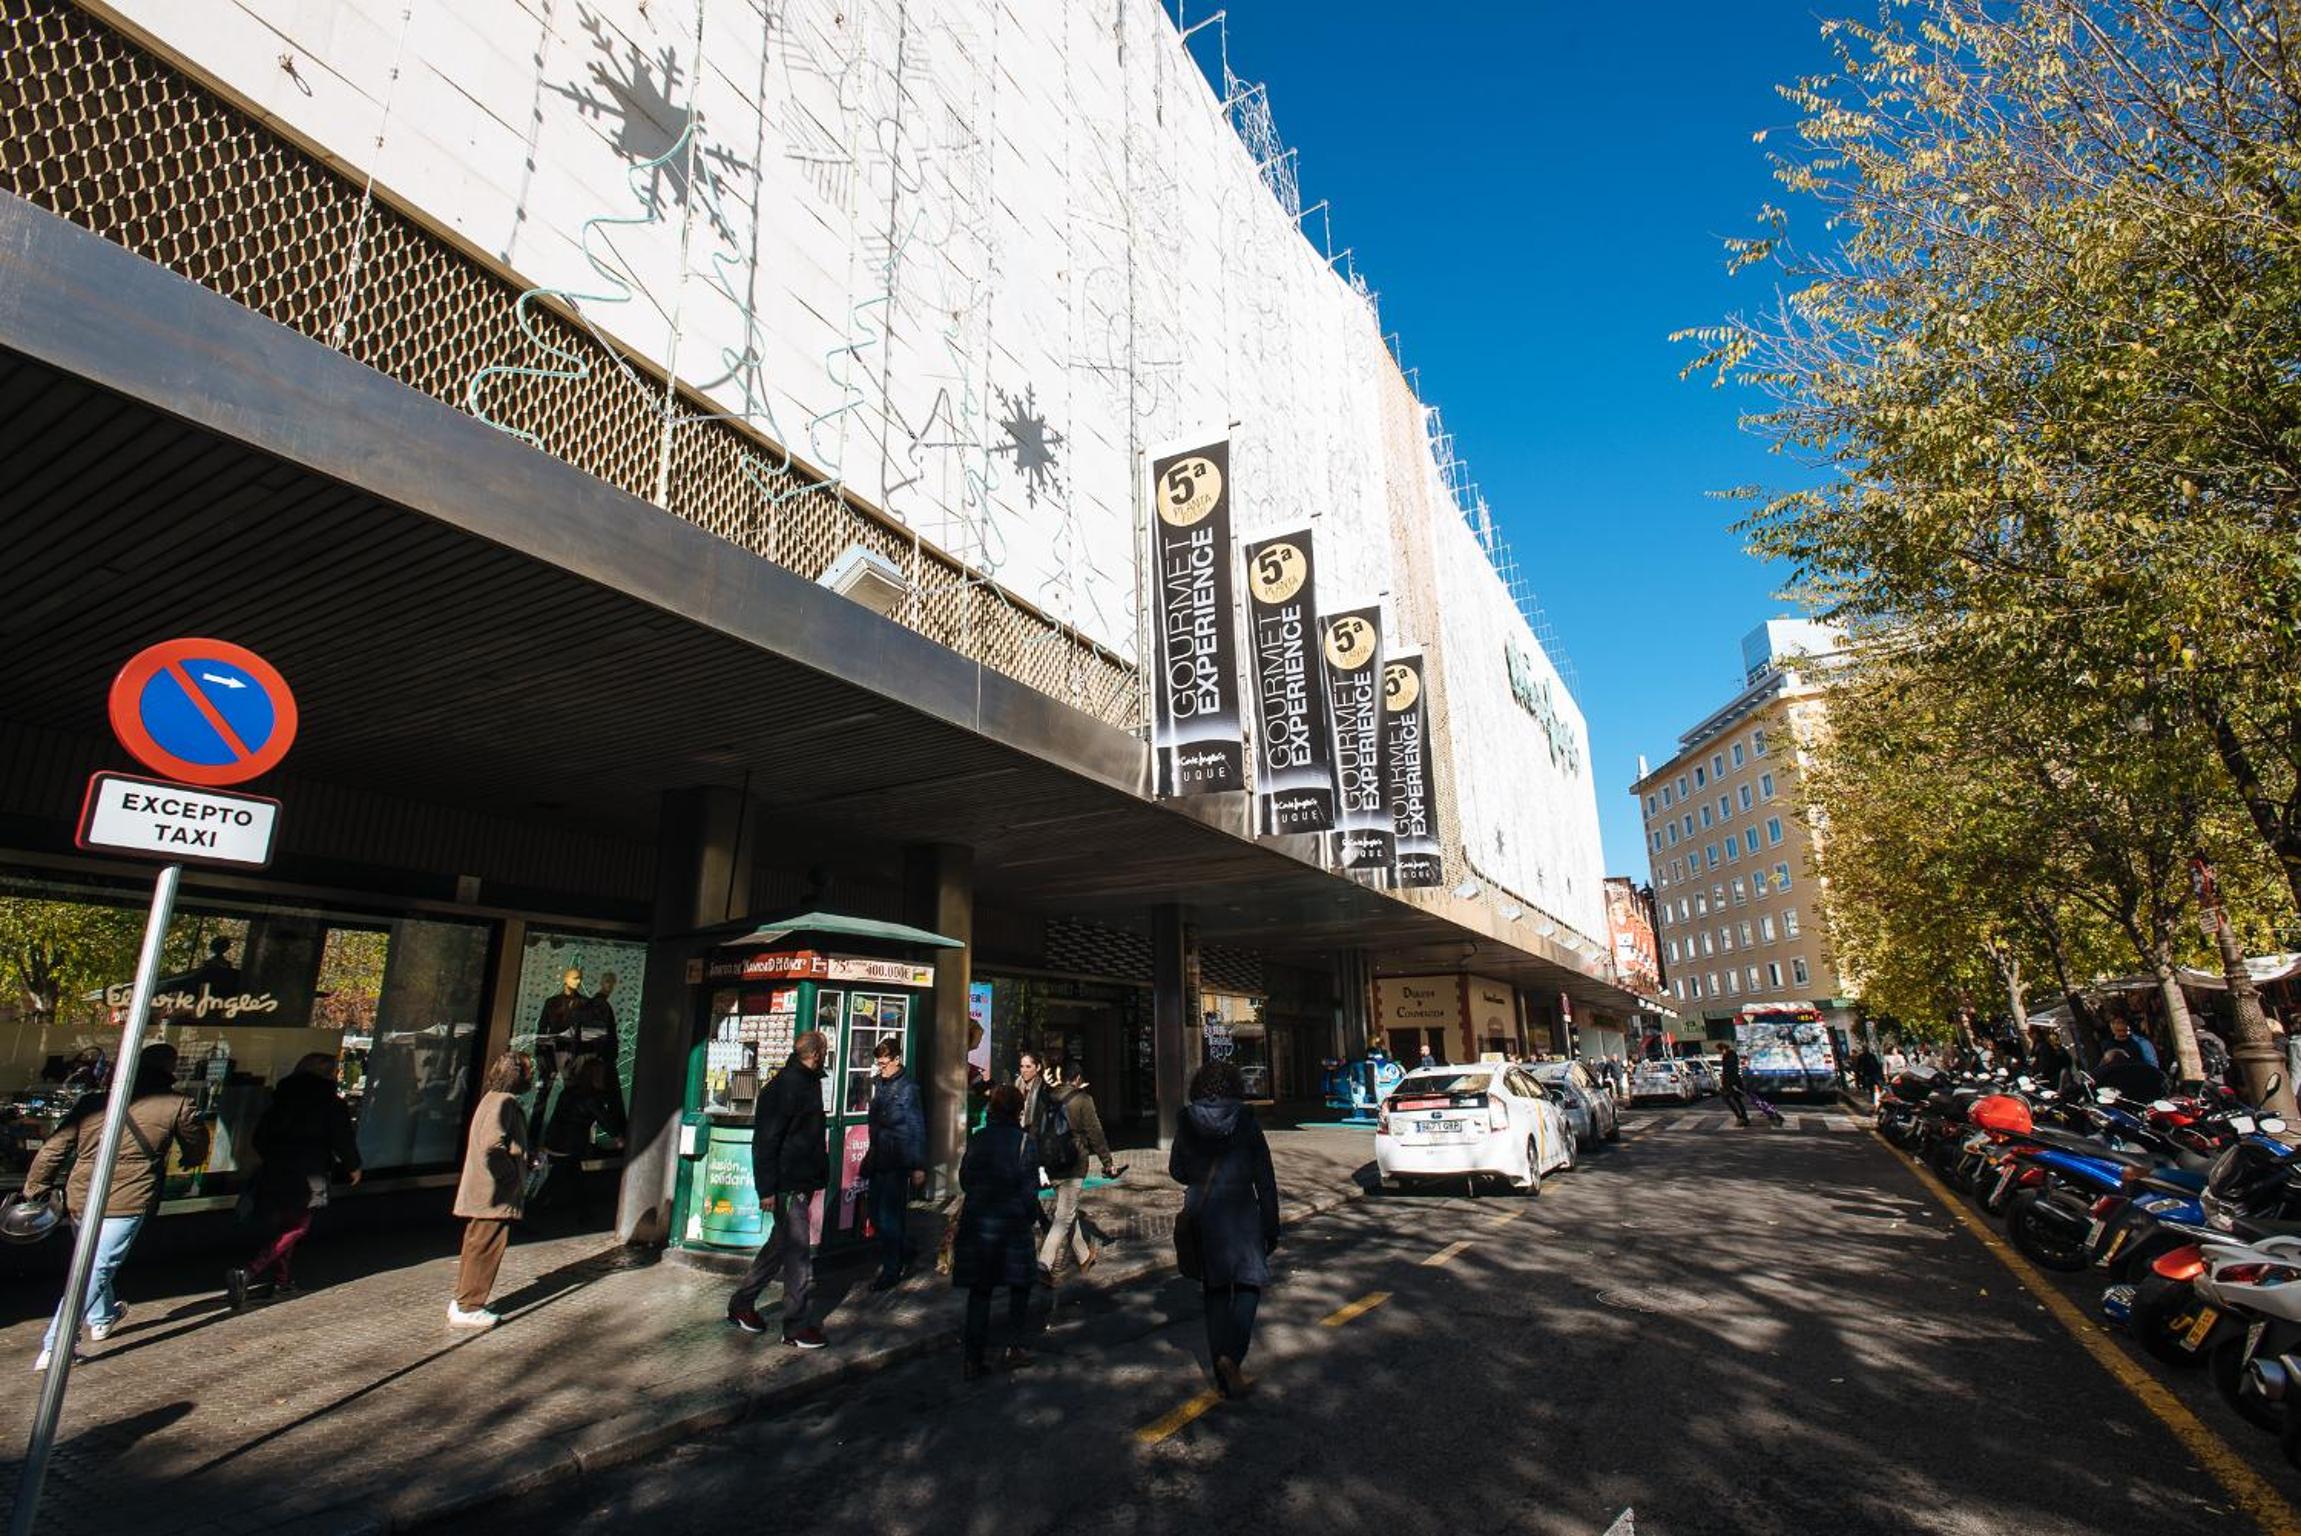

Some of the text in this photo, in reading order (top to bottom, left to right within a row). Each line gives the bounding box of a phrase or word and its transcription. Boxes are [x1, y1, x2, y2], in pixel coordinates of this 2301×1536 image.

[1166, 536, 1198, 719] GOURMET
[1191, 526, 1221, 715] EXPERIENCE
[1281, 604, 1313, 767] EXPERIENCE
[1257, 613, 1292, 770] GOURMET
[1332, 675, 1363, 812] GOURMET
[1353, 670, 1381, 812] EXPERIENCE
[121, 792, 253, 827] EXCEPTO
[154, 823, 218, 848] TAXI
[1180, 766, 1226, 782] UQUE
[1279, 810, 1319, 824] UQUE
[1401, 713, 1428, 837] EXPERIENCE
[151, 990, 196, 1010] orte
[196, 981, 279, 1019] Inglés
